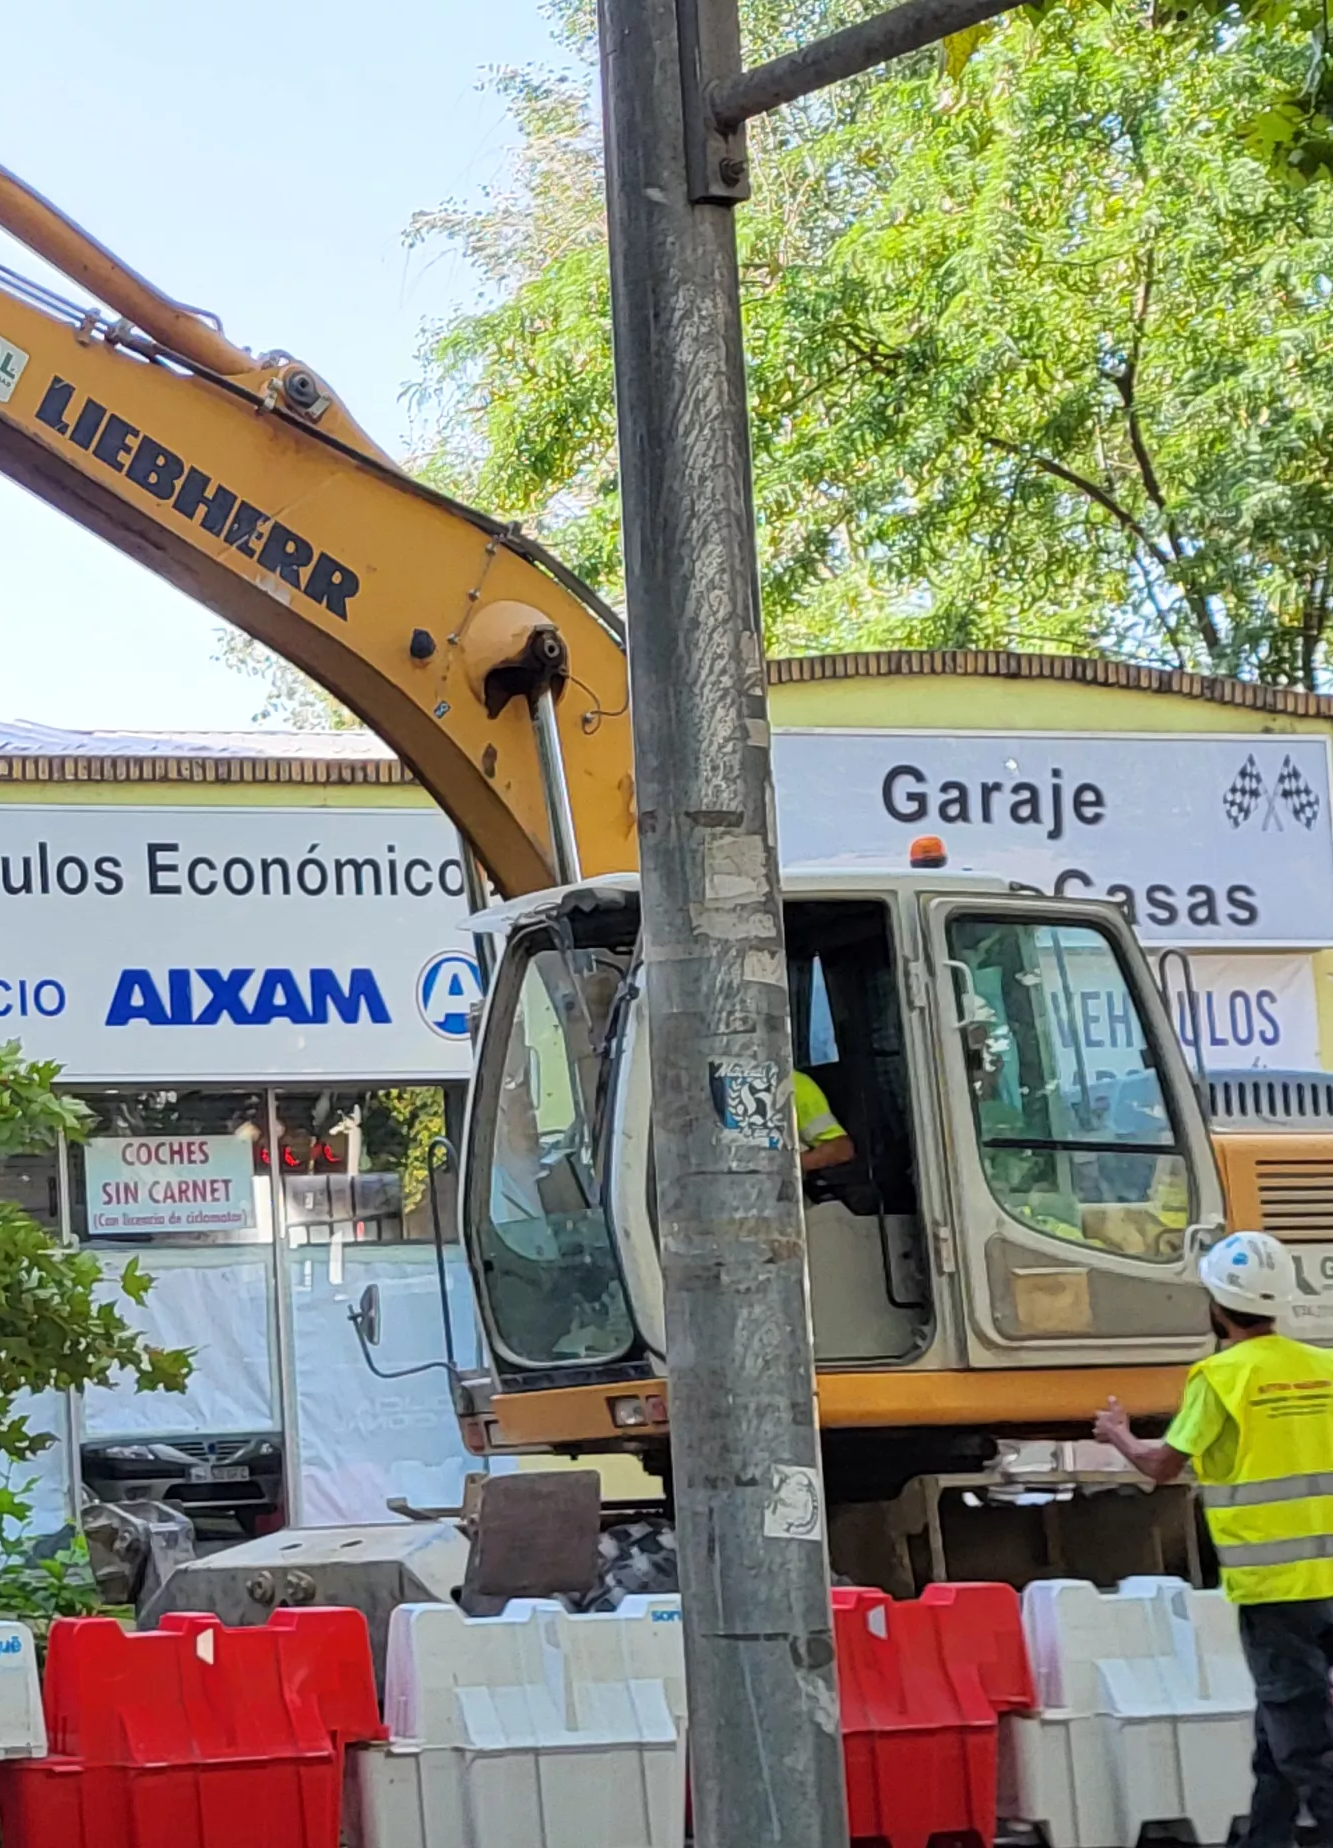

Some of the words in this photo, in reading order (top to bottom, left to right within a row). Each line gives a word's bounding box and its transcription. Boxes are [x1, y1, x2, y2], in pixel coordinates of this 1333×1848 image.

[34, 374, 360, 622] LIEBHERR
[882, 764, 1108, 840] Garaje
[146, 842, 501, 897] Económico
[104, 968, 393, 1026] AIXAM
[1050, 988, 1281, 1049] VEHULOS
[121, 1141, 210, 1167] COCHES
[102, 1181, 139, 1206] SIN
[148, 1179, 233, 1205] CARNET
